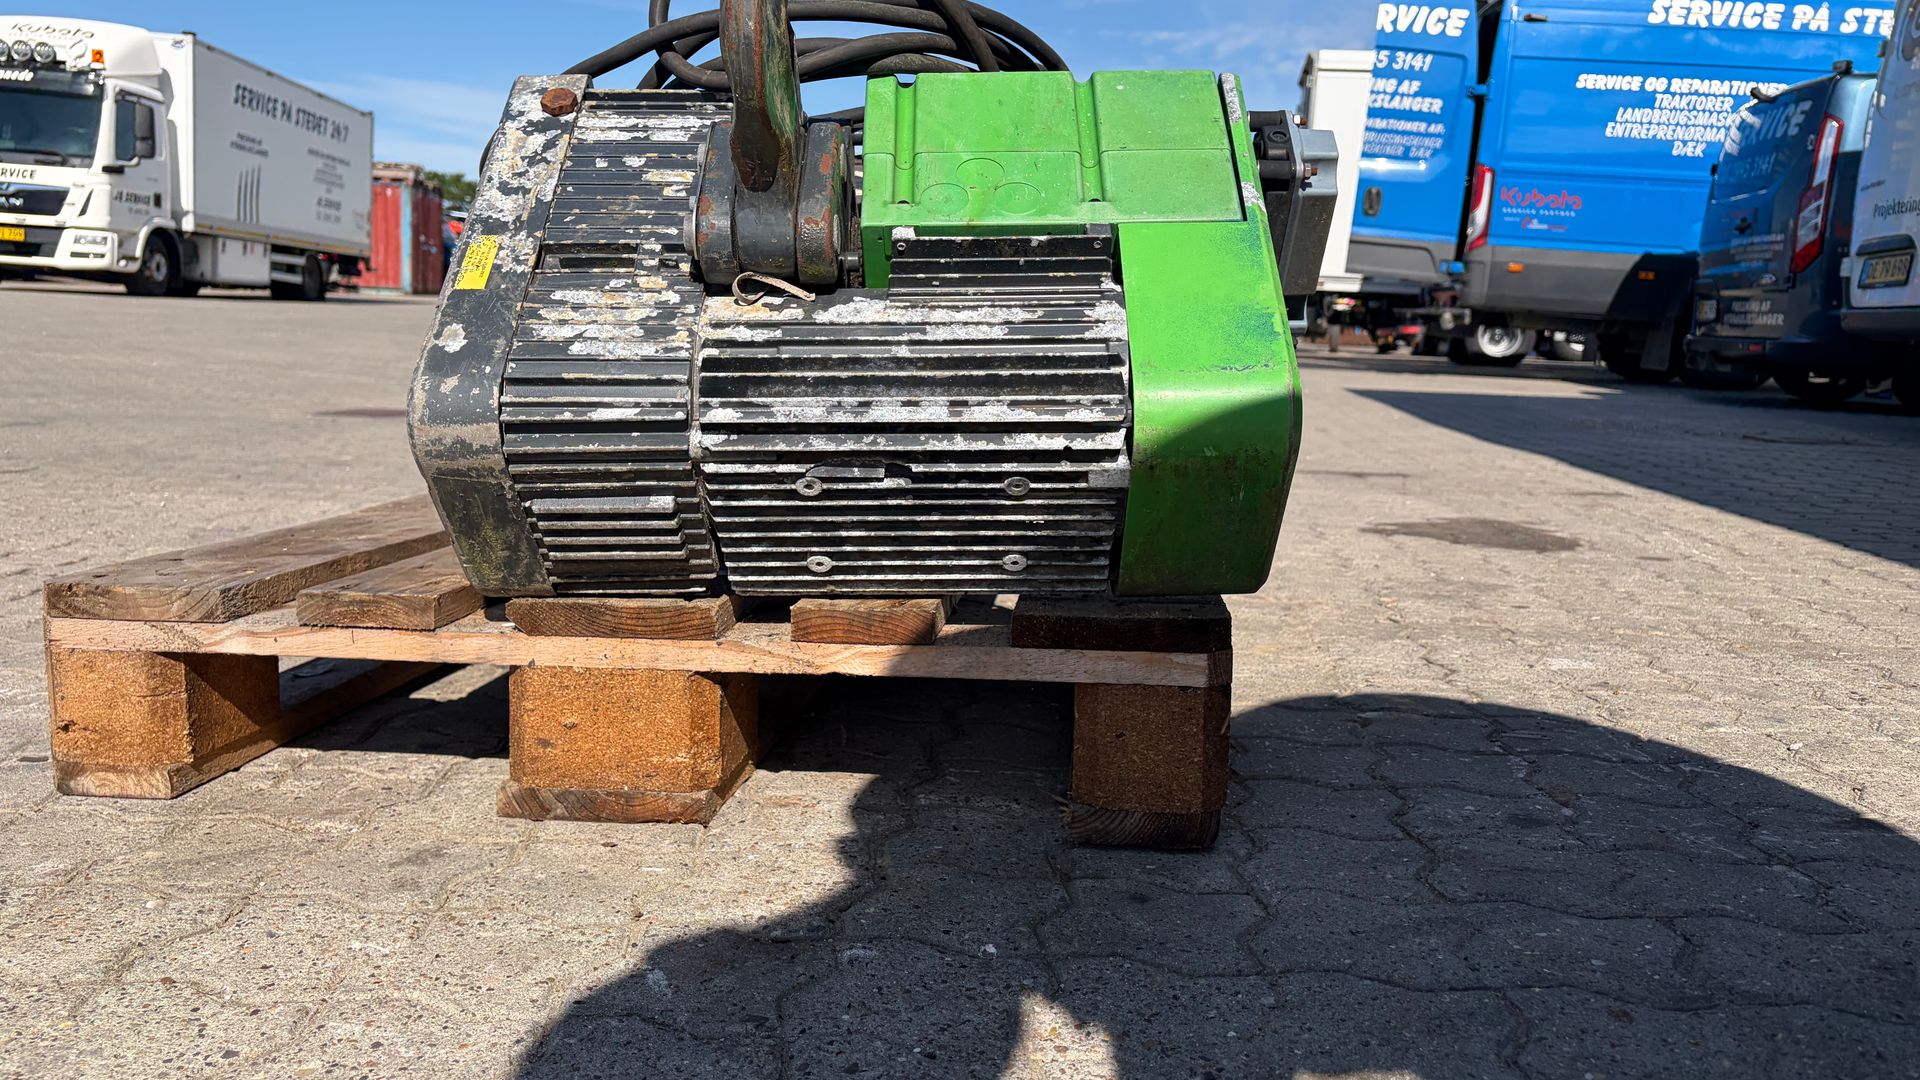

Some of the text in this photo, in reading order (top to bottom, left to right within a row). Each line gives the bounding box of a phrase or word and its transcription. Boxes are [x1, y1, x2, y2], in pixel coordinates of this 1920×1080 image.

[1648, 0, 1786, 30] SERVICE
[1791, 2, 1830, 32] PÅ
[1392, 51, 1433, 72] 3141
[1397, 79, 1422, 95] AF
[1575, 73, 1643, 91] SERVICE
[1645, 77, 1668, 92] OG
[233, 81, 279, 120] SERVICE
[1654, 93, 1735, 112] TRAKTORER
[1671, 140, 1708, 158] DÆK
[1501, 186, 1582, 210] Kubota
